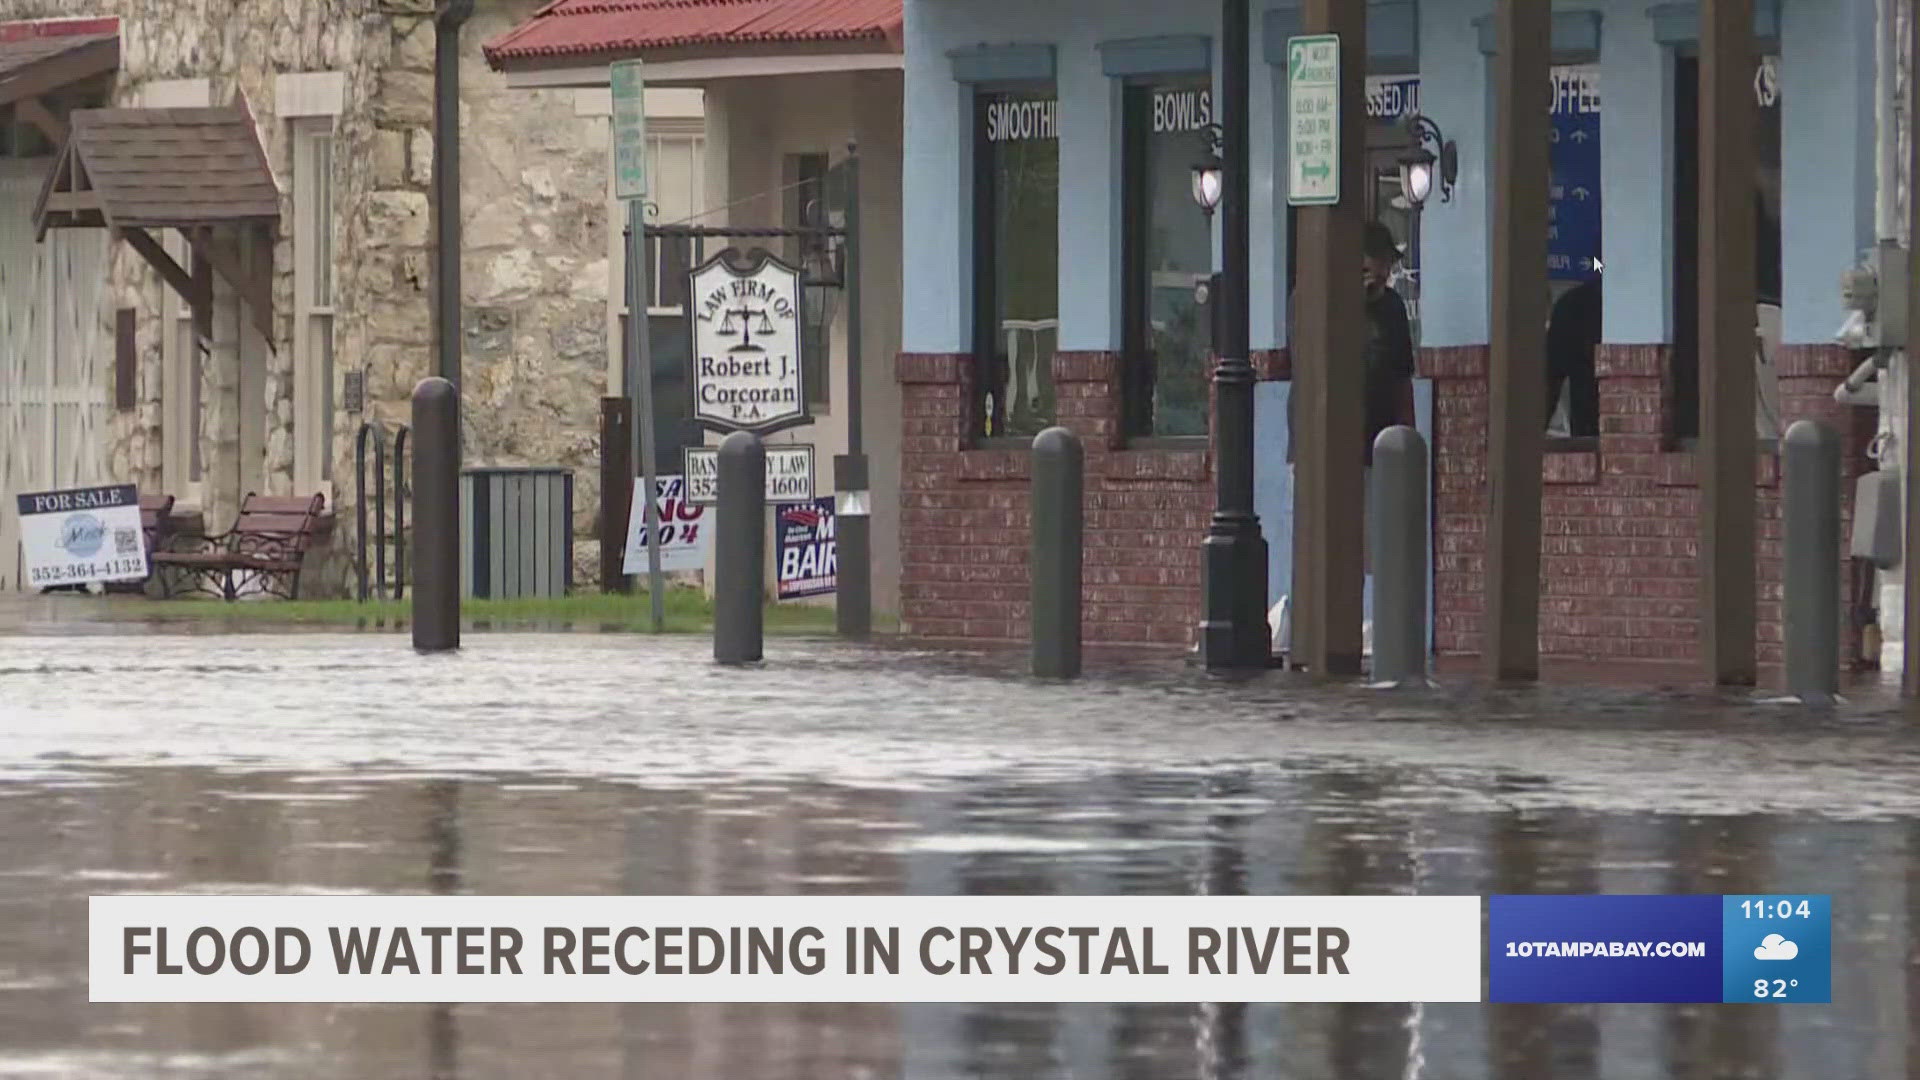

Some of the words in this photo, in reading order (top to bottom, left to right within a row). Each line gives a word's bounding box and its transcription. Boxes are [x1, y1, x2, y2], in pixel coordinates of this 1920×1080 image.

[1289, 43, 1307, 80] 2
[1153, 90, 1211, 132] BOWLS
[697, 284, 729, 323] LAW
[730, 279, 776, 304] FIRM
[774, 297, 795, 320] OF
[700, 356, 771, 377] Robert
[779, 355, 796, 380] J.
[701, 384, 796, 405] Corcoran
[779, 454, 808, 474] LAW
[35, 494, 74, 512] FOR
[75, 488, 122, 508] SALE
[679, 523, 699, 544] 4
[32, 559, 143, 580] 352-364-4132
